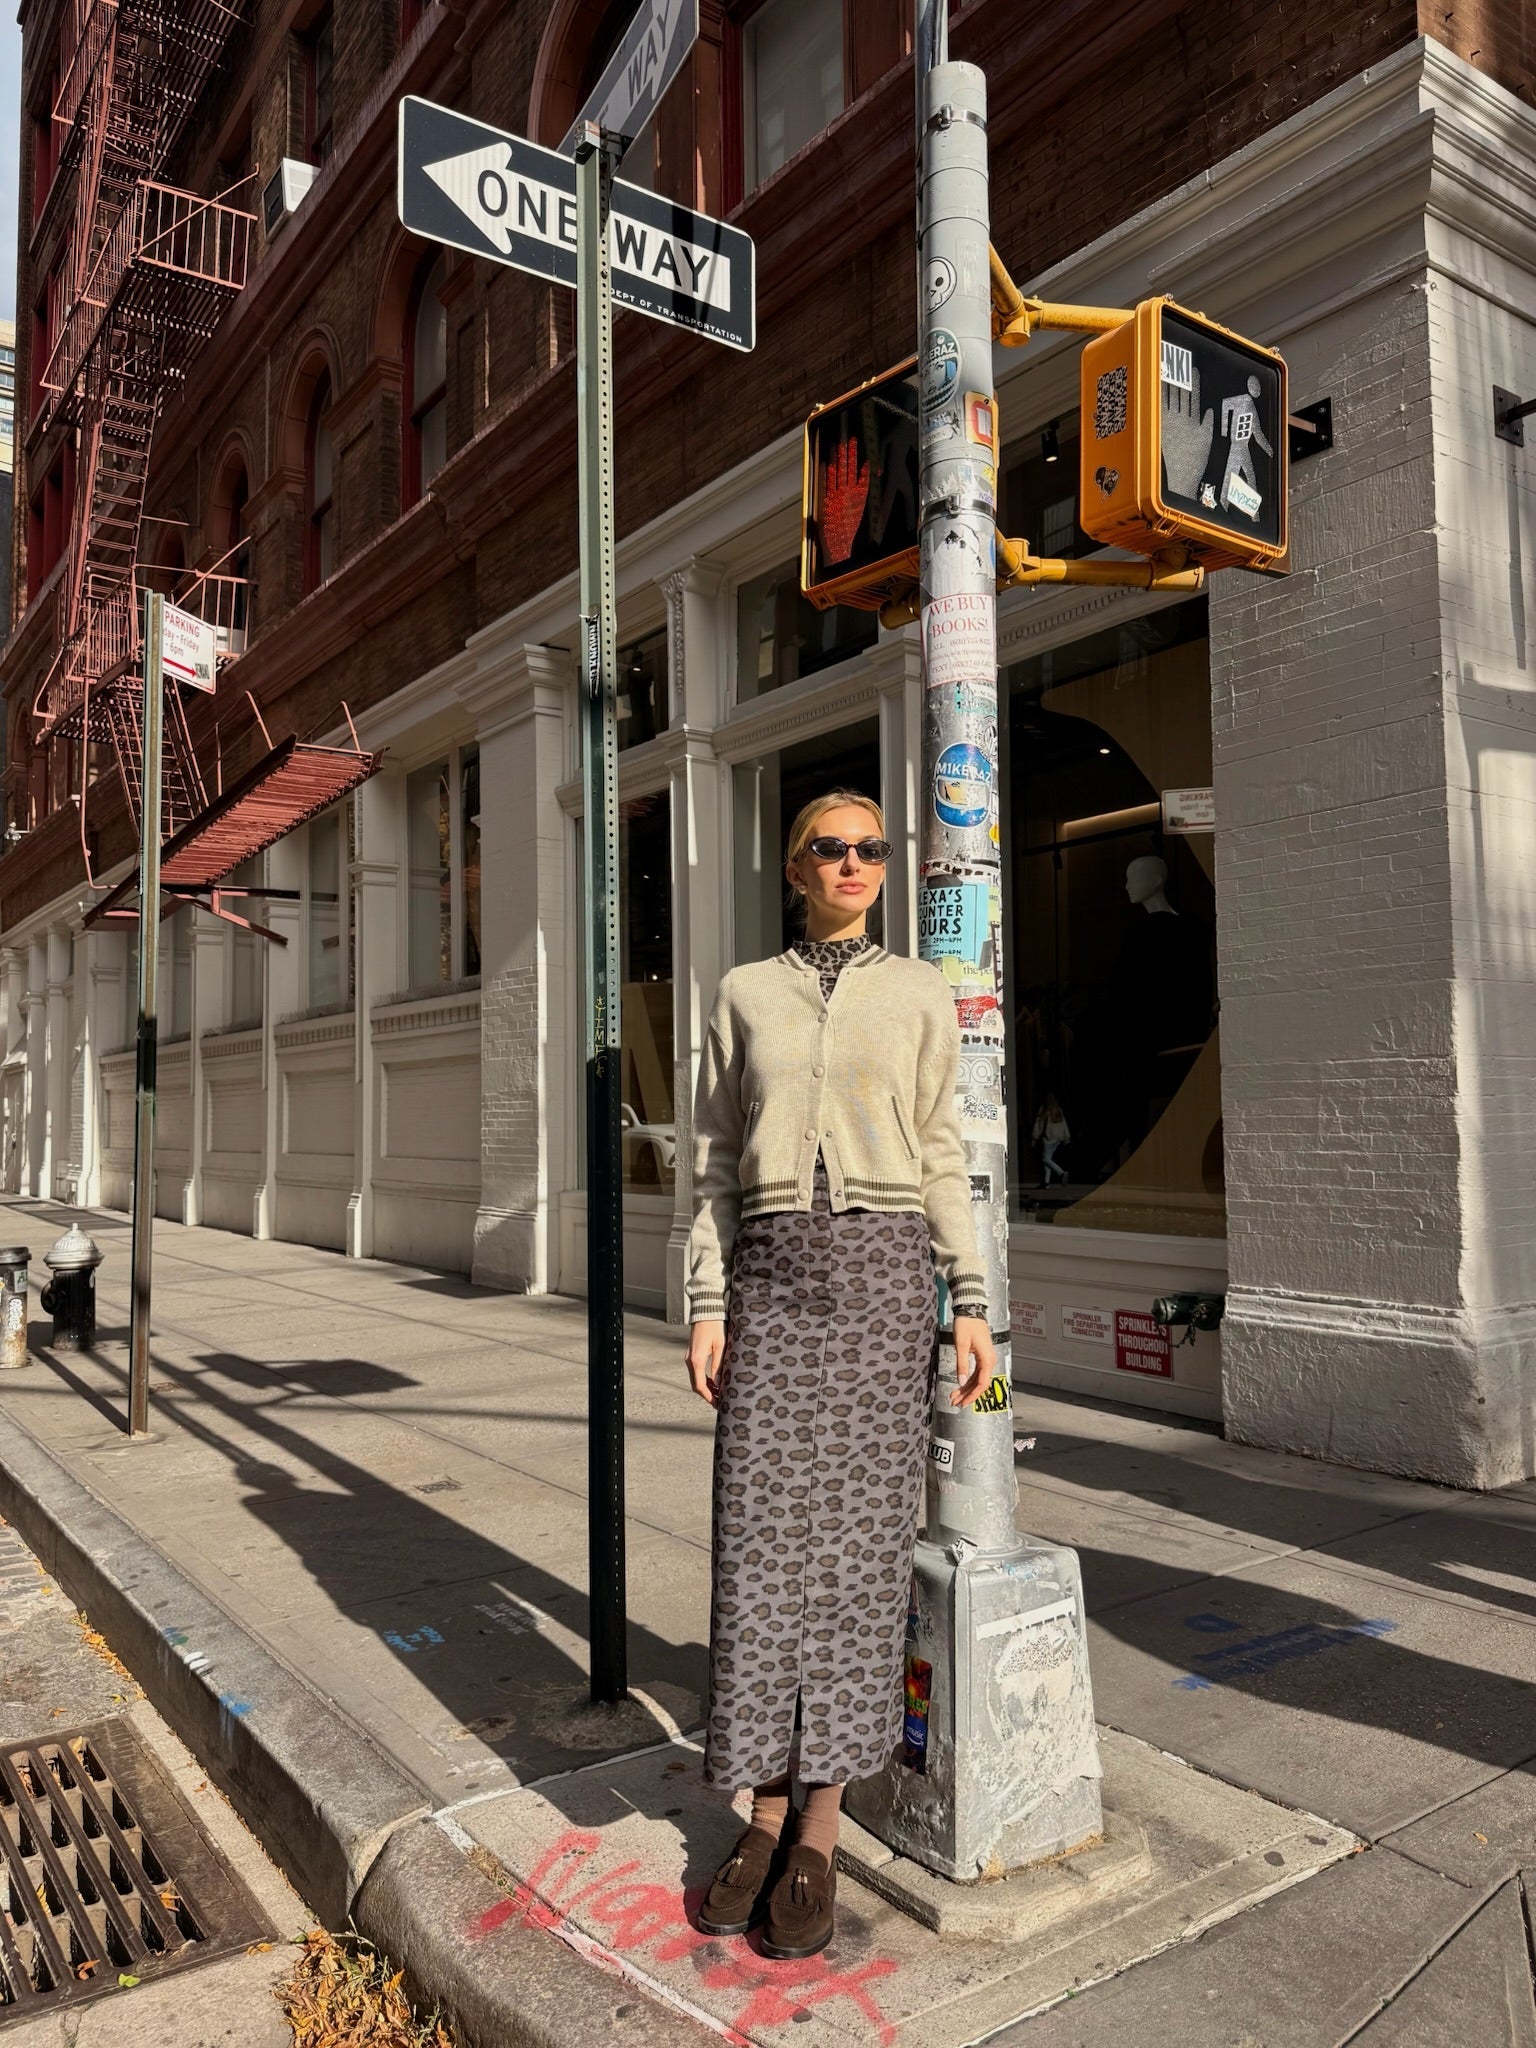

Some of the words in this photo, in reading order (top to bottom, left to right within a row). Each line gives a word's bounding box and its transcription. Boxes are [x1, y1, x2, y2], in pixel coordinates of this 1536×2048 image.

[628, 0, 670, 107] WAY
[477, 169, 577, 245] ONE
[614, 218, 710, 295] WAY
[610, 288, 636, 303] DEPT
[639, 299, 653, 309] OF
[657, 305, 742, 343] TRANSPORTATION
[929, 598, 954, 617] WE
[958, 596, 987, 611] BUY
[165, 611, 200, 638] PARKING
[932, 617, 989, 638] BOOKS!
[180, 635, 200, 654] Friday
[963, 965, 979, 975] the
[1063, 1317, 1075, 1326] FIRE
[1076, 1319, 1111, 1332] DEPARTMENT
[1072, 1312, 1102, 1322] SPRINKLER
[1118, 1316, 1167, 1337] SPRINKLES
[1071, 1327, 1105, 1338] CONNECTION
[1117, 1332, 1169, 1355] THROUGHOUT
[1125, 1351, 1163, 1372] BUILDING
[906, 1725, 925, 1740] music
